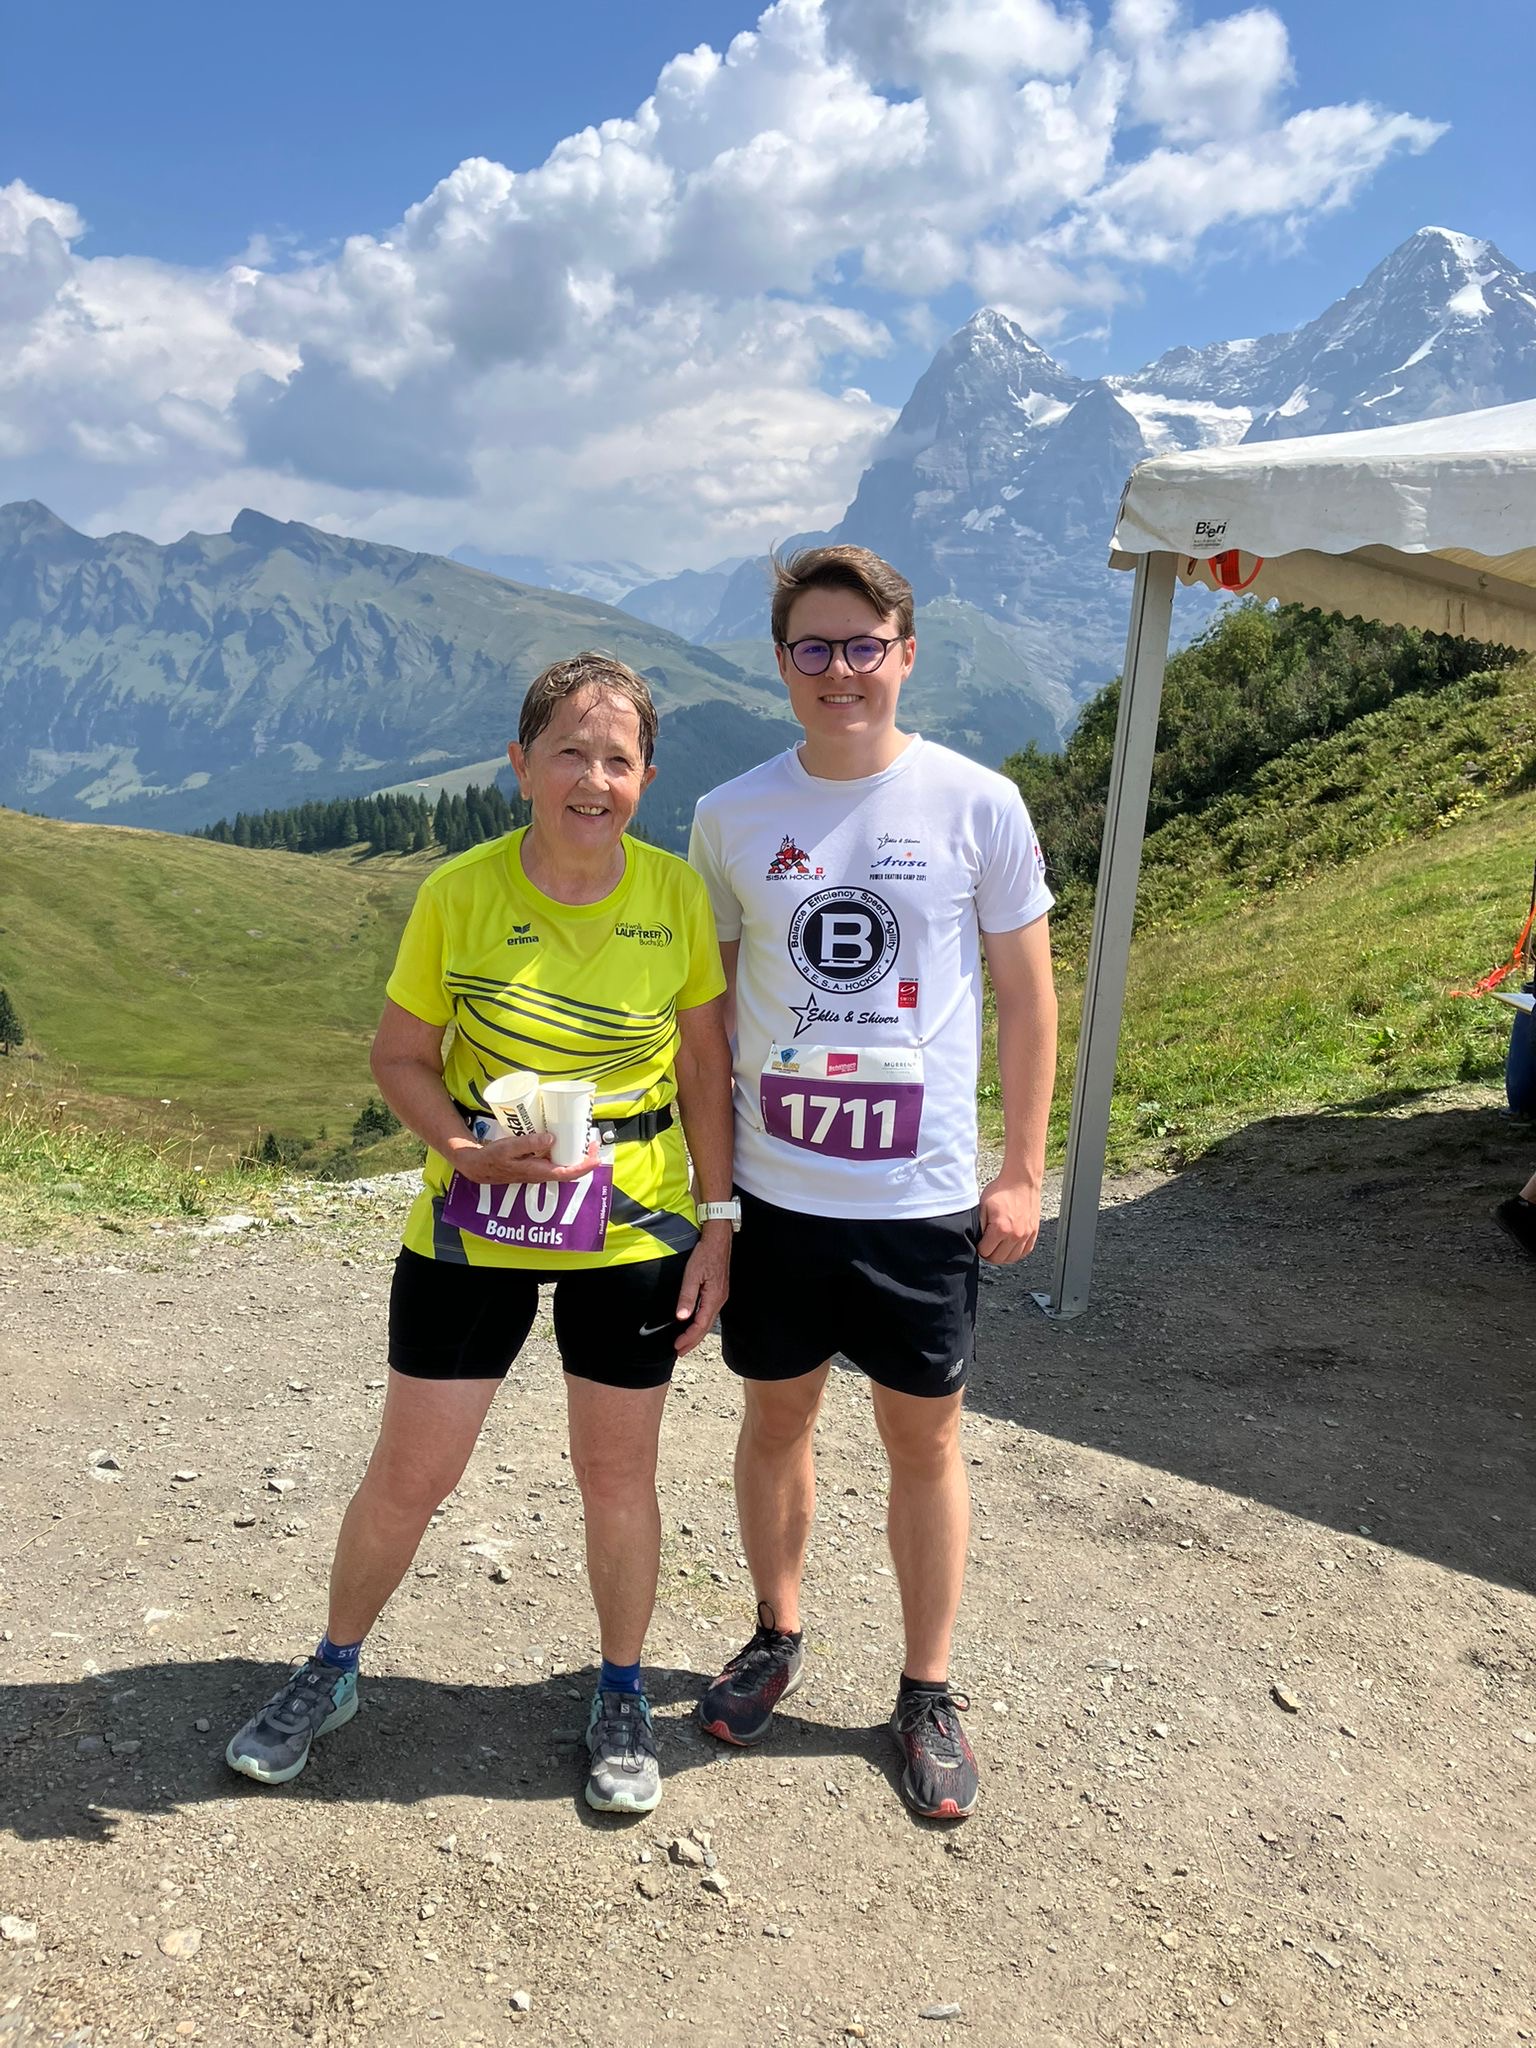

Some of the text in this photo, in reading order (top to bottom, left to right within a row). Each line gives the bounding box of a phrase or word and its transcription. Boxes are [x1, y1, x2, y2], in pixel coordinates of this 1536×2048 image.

[1195, 521, 1227, 538] Bieri
[870, 855, 927, 868] Arosa
[765, 874, 826, 882] SISM HOCKEY
[903, 873, 916, 881] CAMP
[791, 890, 897, 951] Balance Efficiency Speed Agility
[507, 935, 540, 946] erima
[615, 927, 662, 939] LAUF-TREFF
[820, 913, 873, 962] B
[845, 967, 882, 991] HOCKEY
[844, 1011, 854, 1023] &
[857, 1012, 900, 1024] Shivers
[781, 1093, 897, 1149] 1711
[476, 1171, 594, 1225] 1707
[485, 1220, 564, 1245] Bond Girls
